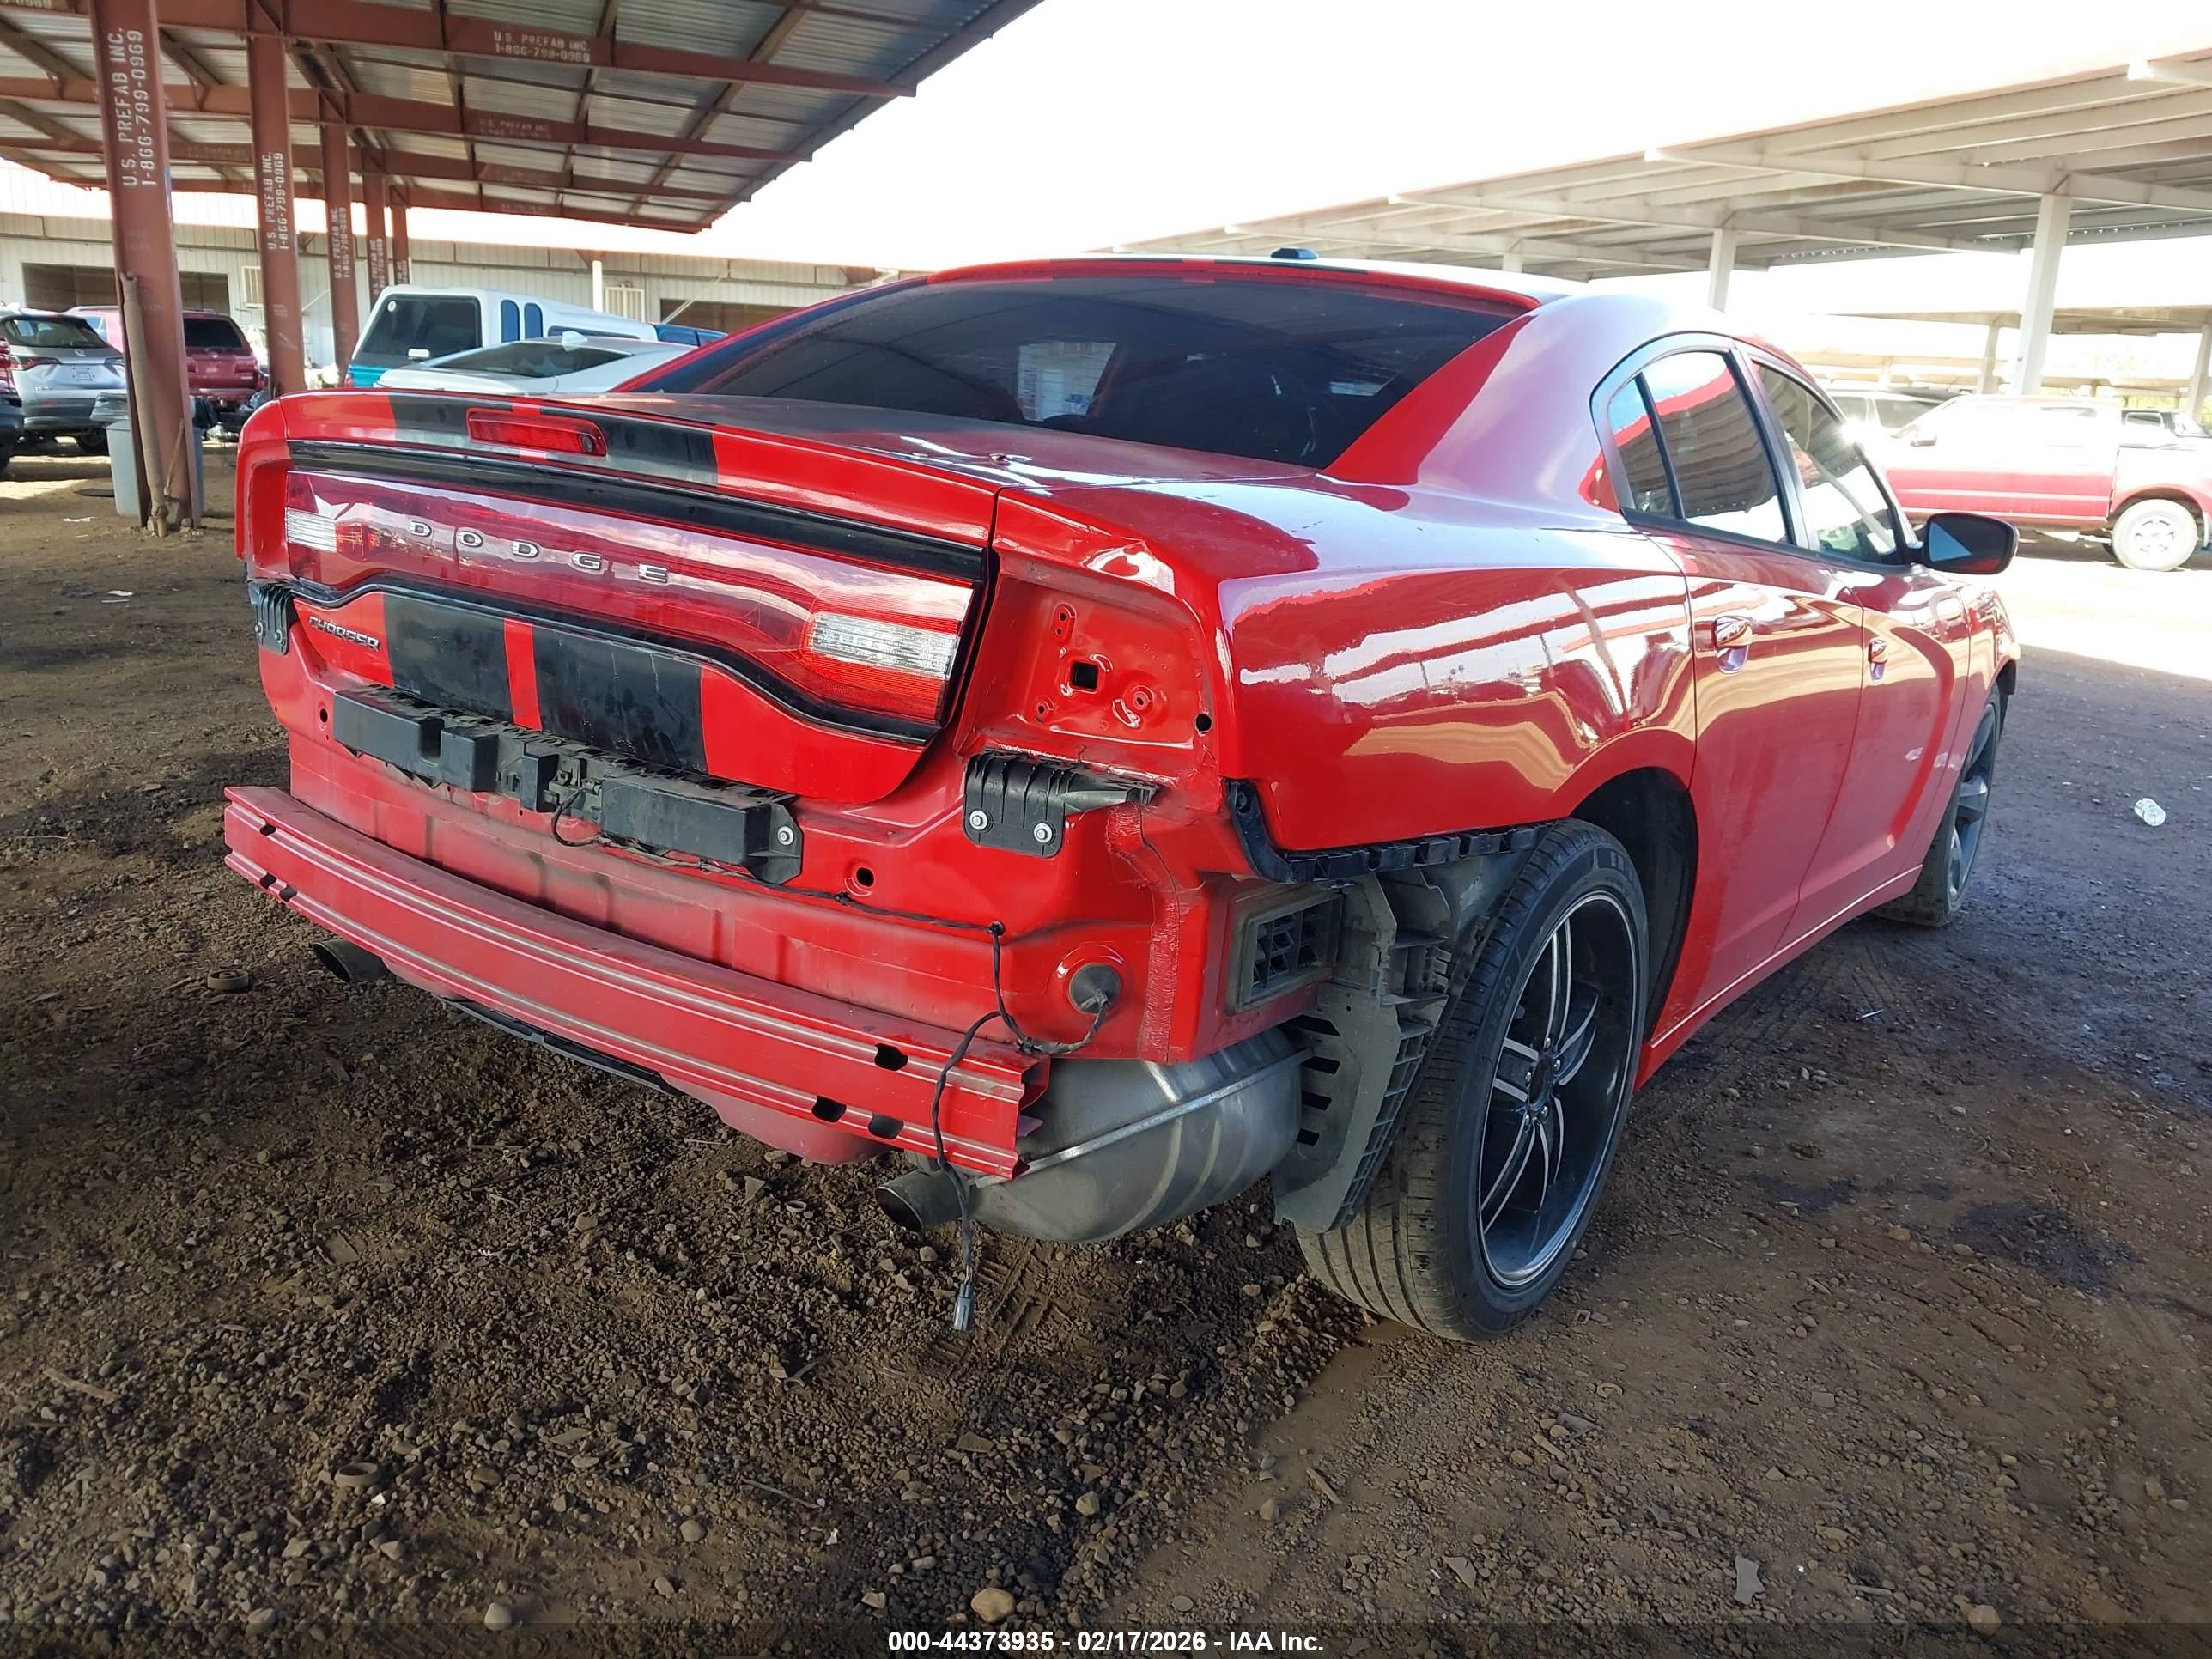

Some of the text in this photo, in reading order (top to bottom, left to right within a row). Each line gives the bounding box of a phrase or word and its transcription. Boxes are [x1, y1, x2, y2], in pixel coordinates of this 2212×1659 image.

[108, 27, 137, 186] U.S. PREFAB INC.
[126, 30, 157, 185] 1-866-799-0969
[263, 178, 276, 222] PREFAB
[273, 152, 289, 250] 1-866-799-0969
[409, 520, 668, 583] DODGE
[309, 615, 380, 653] CHARGER
